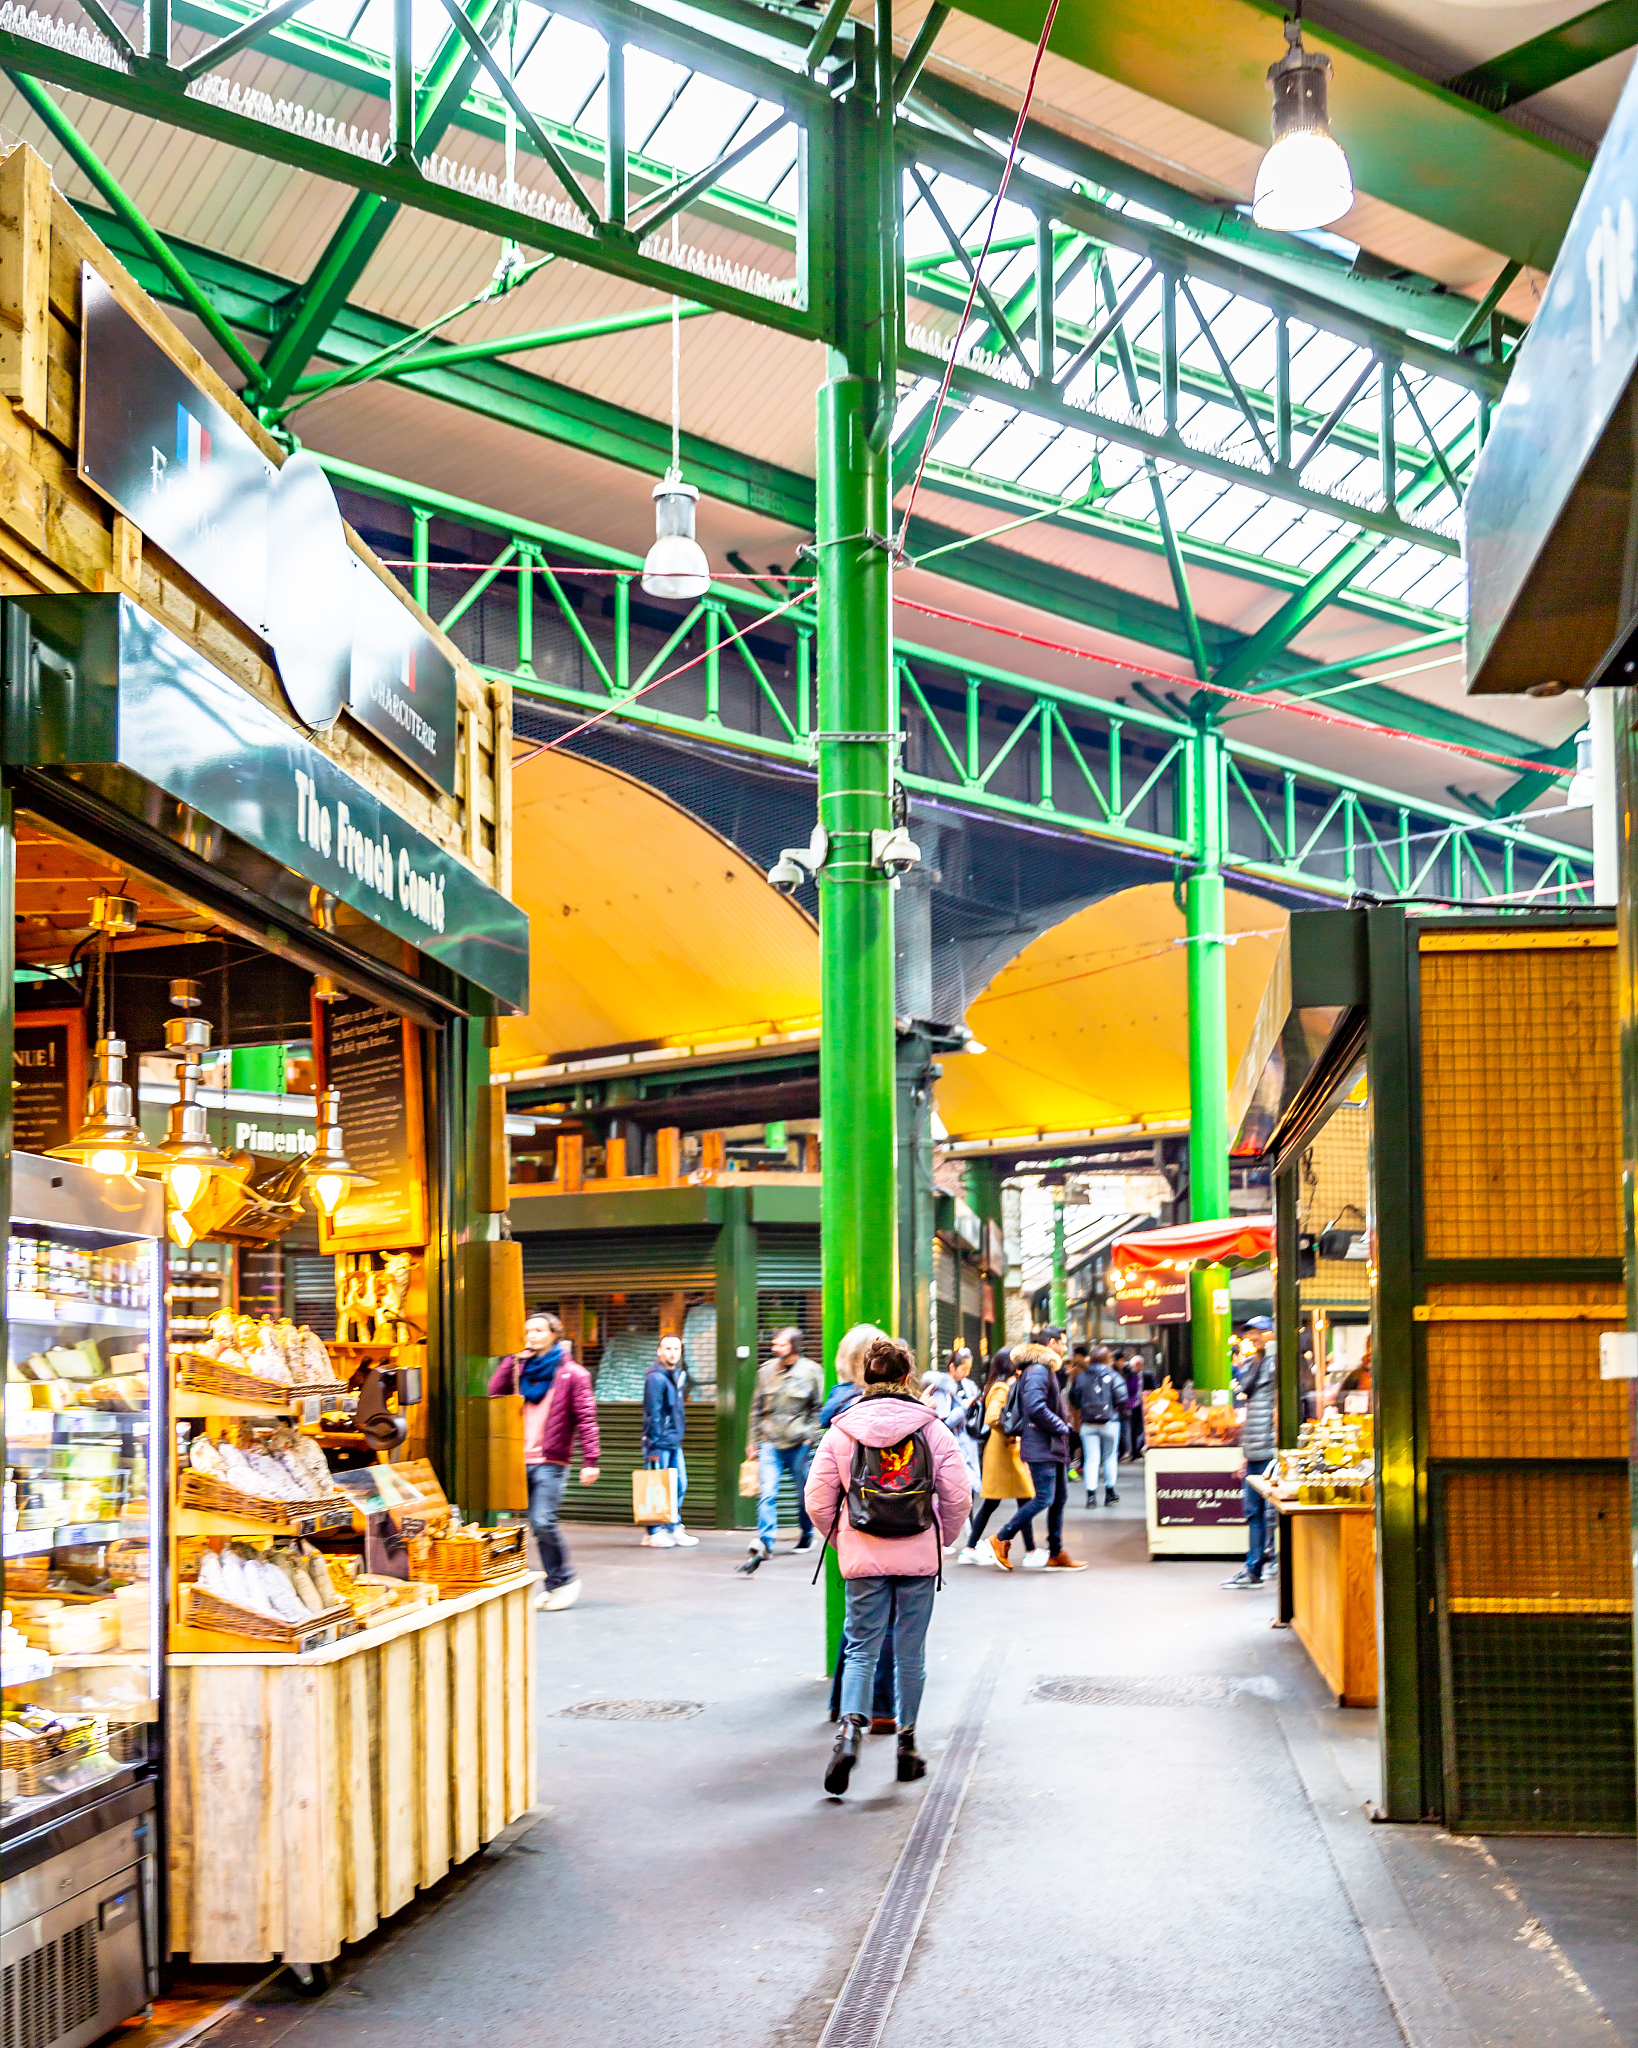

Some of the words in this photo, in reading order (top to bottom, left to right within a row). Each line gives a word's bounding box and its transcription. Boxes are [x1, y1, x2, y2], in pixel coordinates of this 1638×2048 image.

[295, 768, 332, 859] The
[337, 801, 394, 901] French
[398, 847, 446, 934] Comté
[235, 1122, 317, 1156] Pimento
